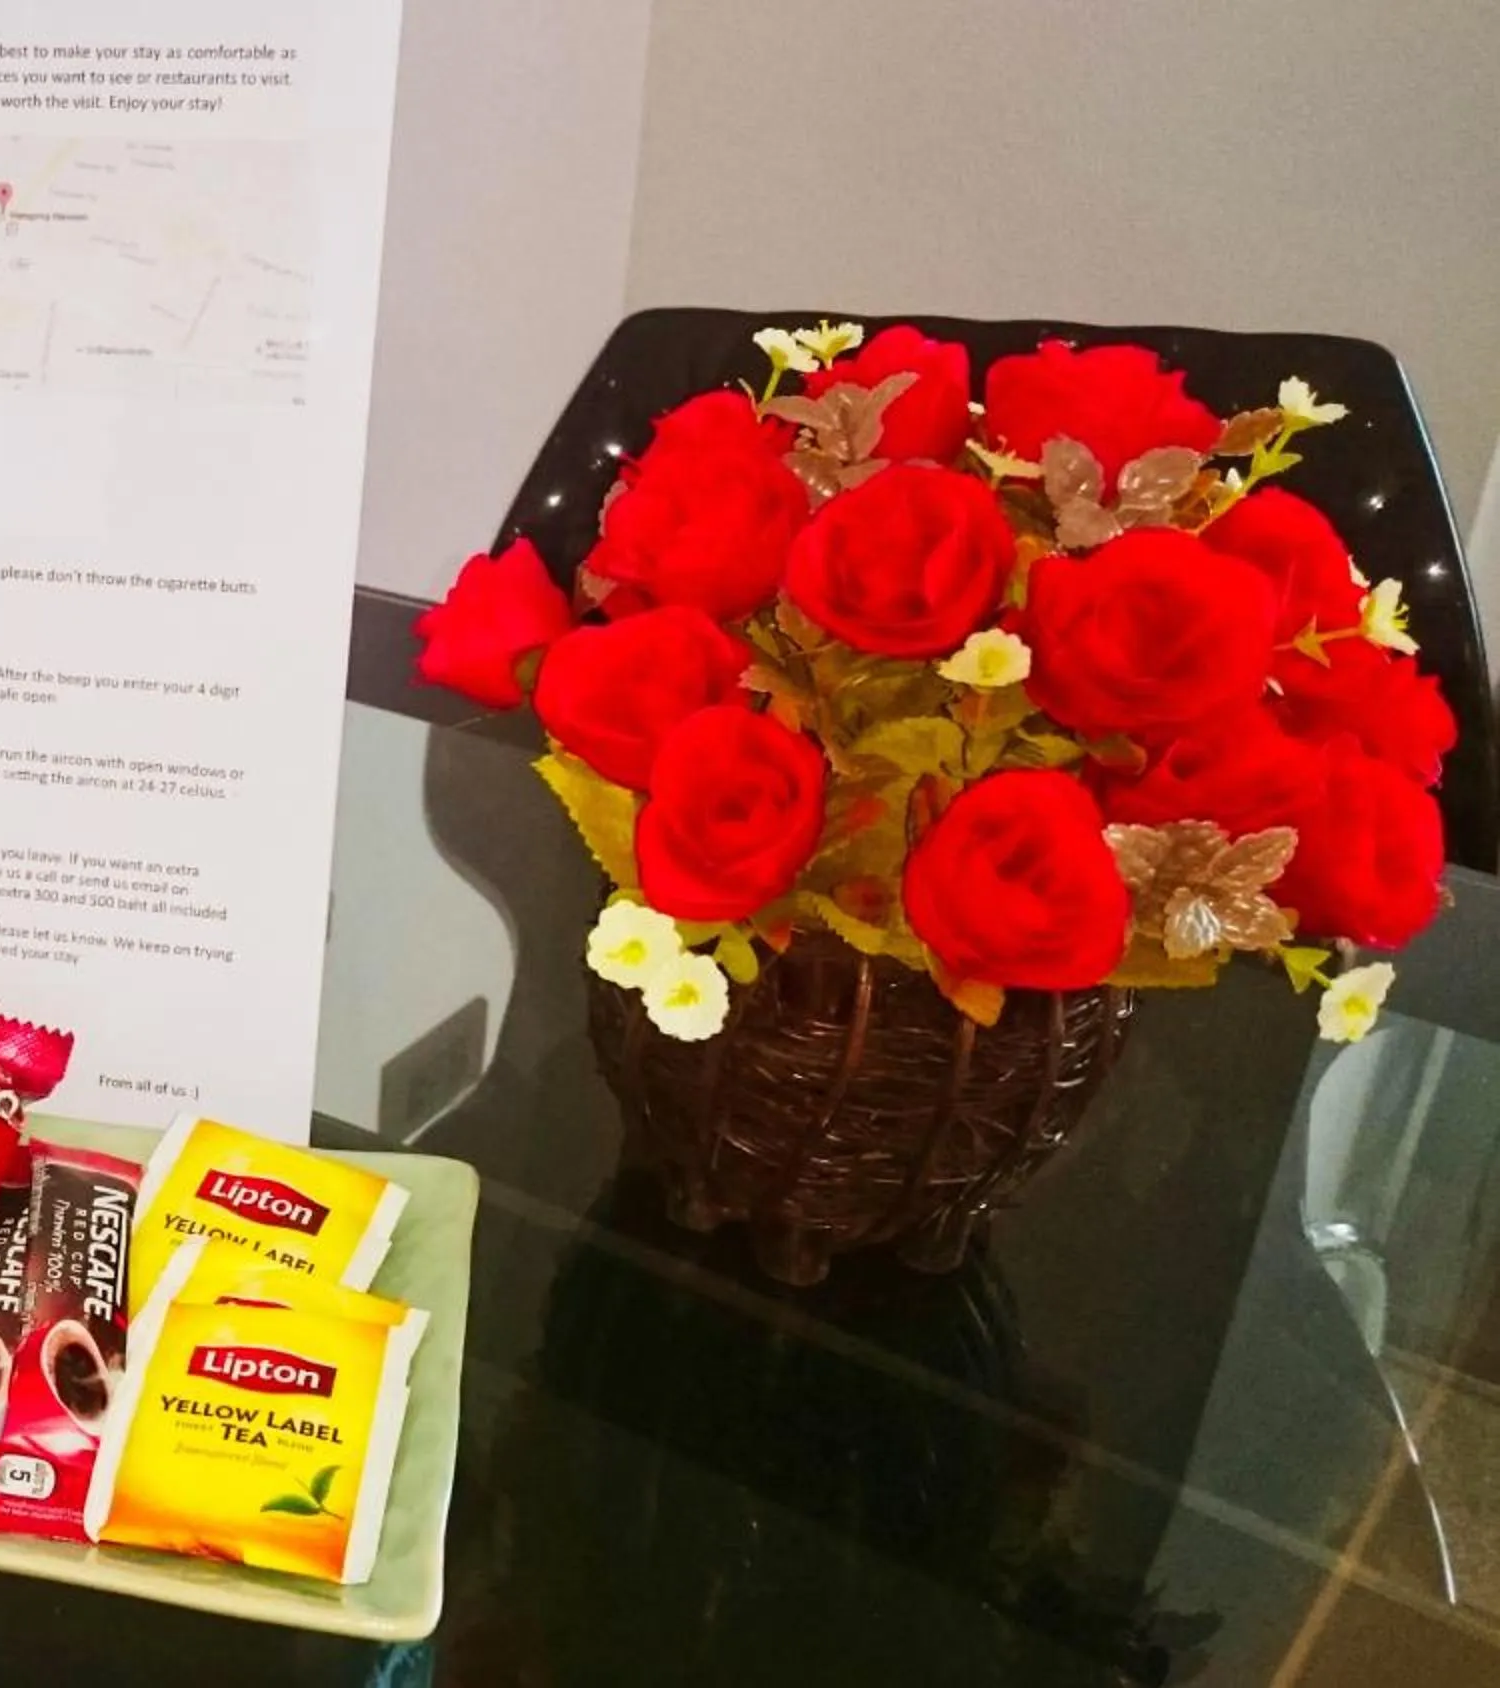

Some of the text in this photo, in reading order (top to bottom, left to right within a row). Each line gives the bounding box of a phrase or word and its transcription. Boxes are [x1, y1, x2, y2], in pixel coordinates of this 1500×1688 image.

[52, 45, 91, 58] make
[94, 47, 128, 60] your
[132, 46, 160, 60] stay
[186, 45, 276, 59] comfortable
[50, 70, 86, 83] want
[154, 72, 237, 85] restaurants
[0, 94, 42, 108] worth
[44, 94, 69, 108] the
[108, 95, 149, 111] Enjoy
[150, 98, 185, 111] your
[186, 96, 222, 111] stay!
[0, 566, 44, 580] please
[46, 569, 82, 583] don't
[85, 571, 126, 585] throw
[156, 578, 217, 591] cigarette
[50, 754, 93, 766] aircon
[94, 757, 125, 768] with
[128, 761, 163, 773] open
[164, 764, 226, 777] windows
[108, 859, 143, 871] want
[33, 888, 59, 902] 300
[98, 1074, 187, 1096] From all of us
[210, 1175, 313, 1225] Lipton
[70, 1208, 87, 1289] RED CUP
[203, 1350, 320, 1389] Lipton
[161, 1394, 343, 1445] YELLOW LABEL
[220, 1423, 268, 1448] TEA
[10, 1468, 31, 1483] 5
